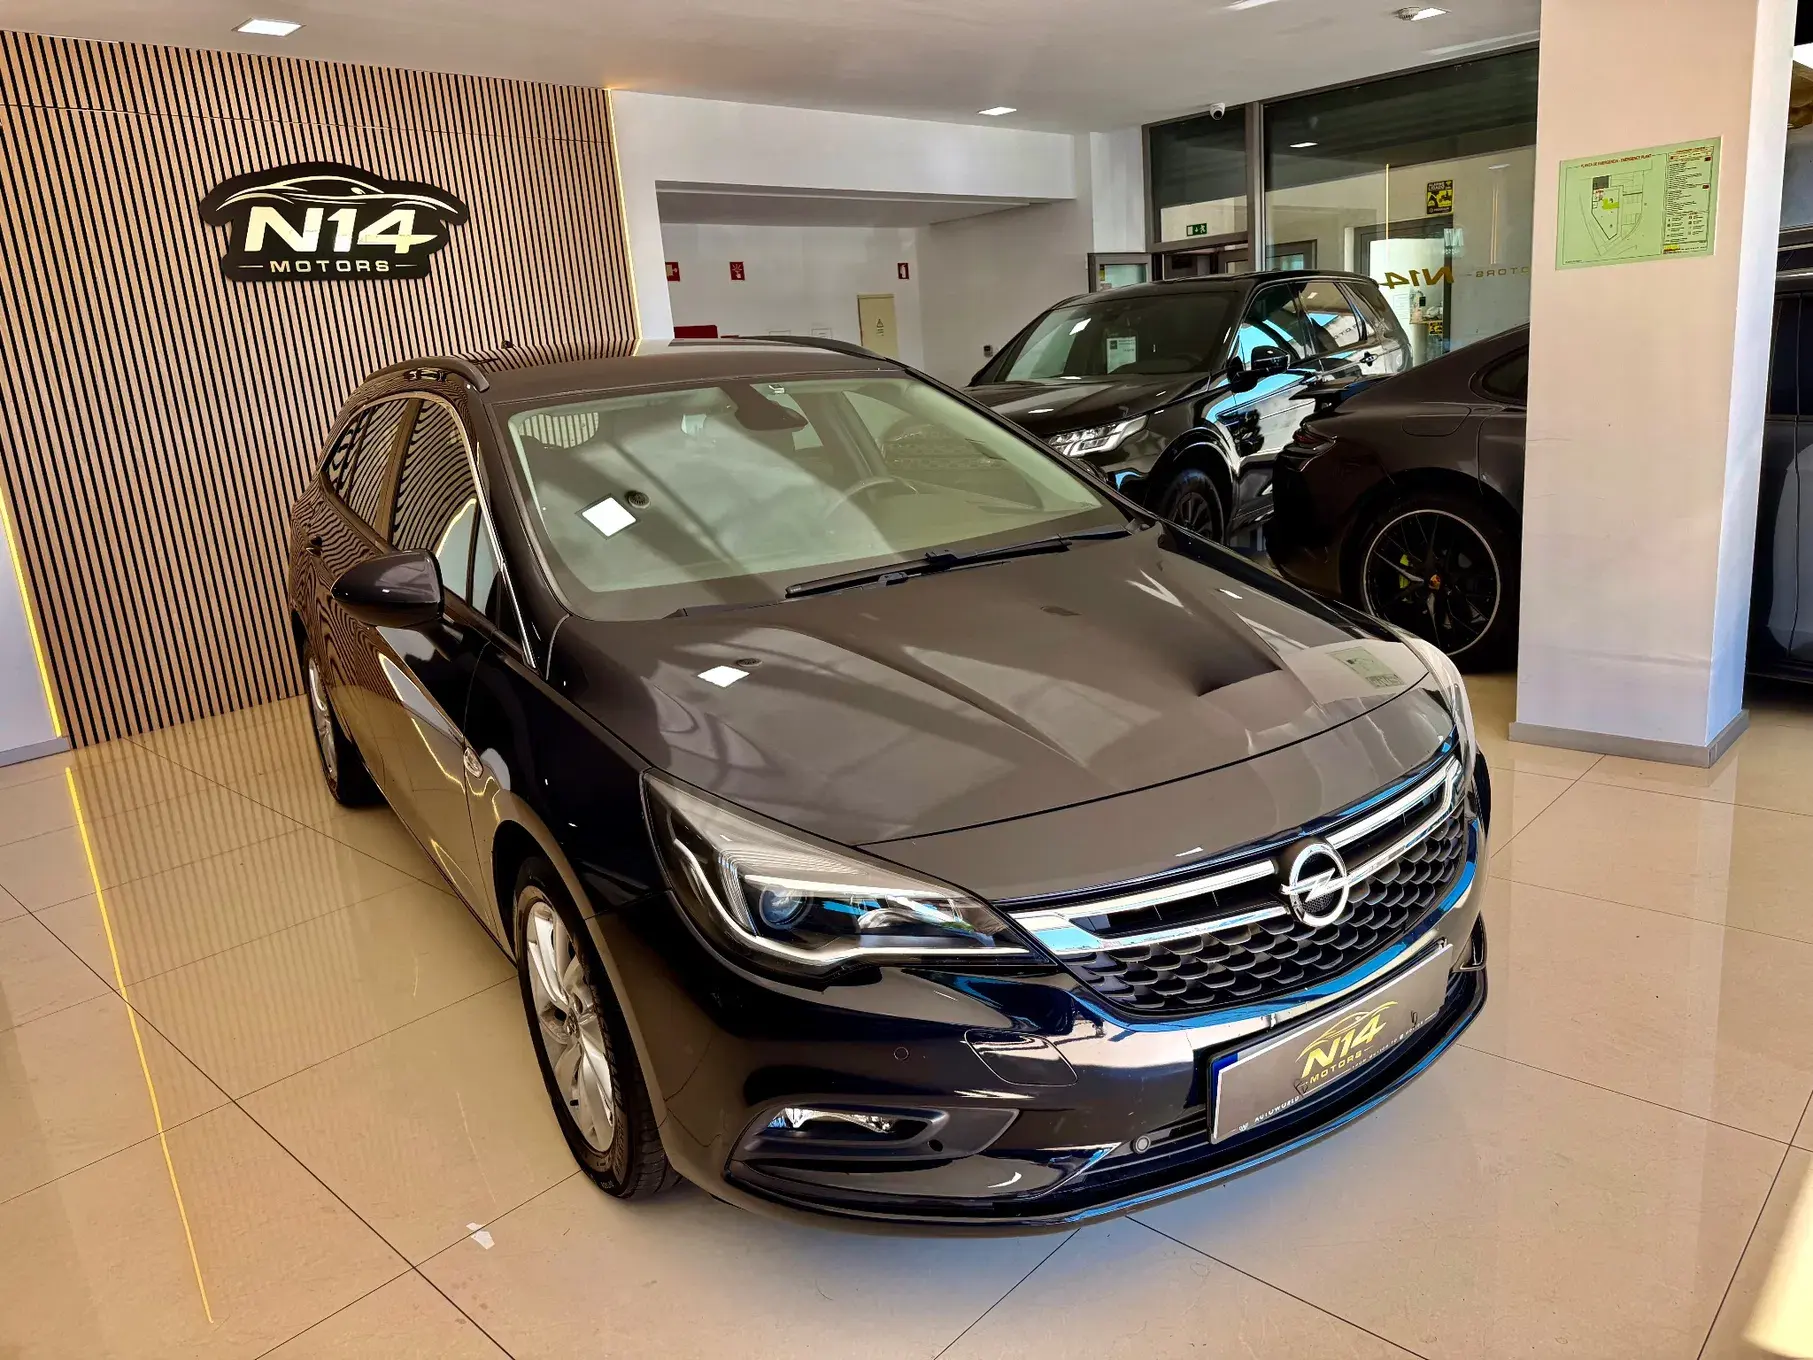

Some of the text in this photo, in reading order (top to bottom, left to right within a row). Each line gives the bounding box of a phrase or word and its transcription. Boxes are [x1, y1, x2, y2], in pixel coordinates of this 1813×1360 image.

[244, 206, 438, 254] N14
[269, 260, 390, 273] MOTORS
[1301, 1013, 1387, 1078] N14
[1310, 1050, 1362, 1084] MOTORS
